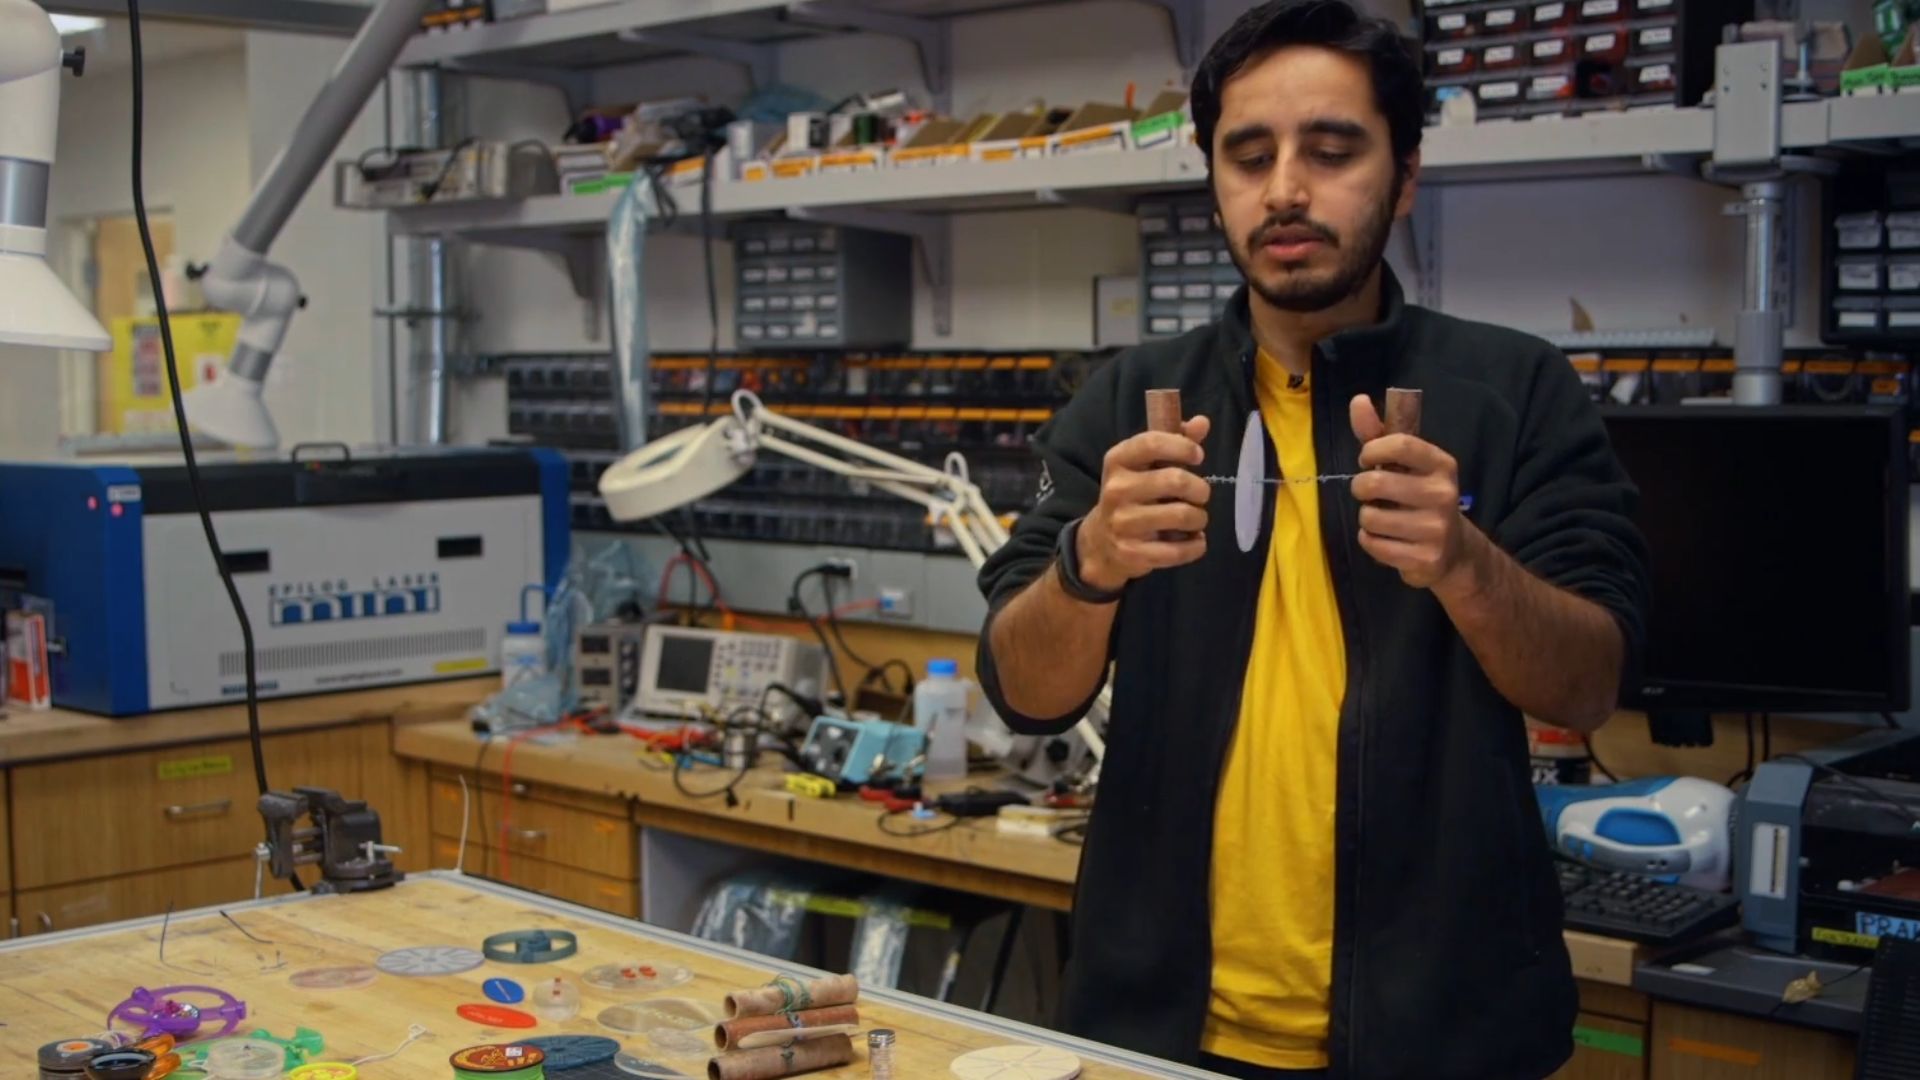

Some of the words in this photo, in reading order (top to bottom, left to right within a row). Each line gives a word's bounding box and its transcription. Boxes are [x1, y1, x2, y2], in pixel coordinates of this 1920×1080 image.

[267, 577, 349, 597] EPILOG
[372, 571, 439, 590] LASER
[269, 585, 441, 628] mini
